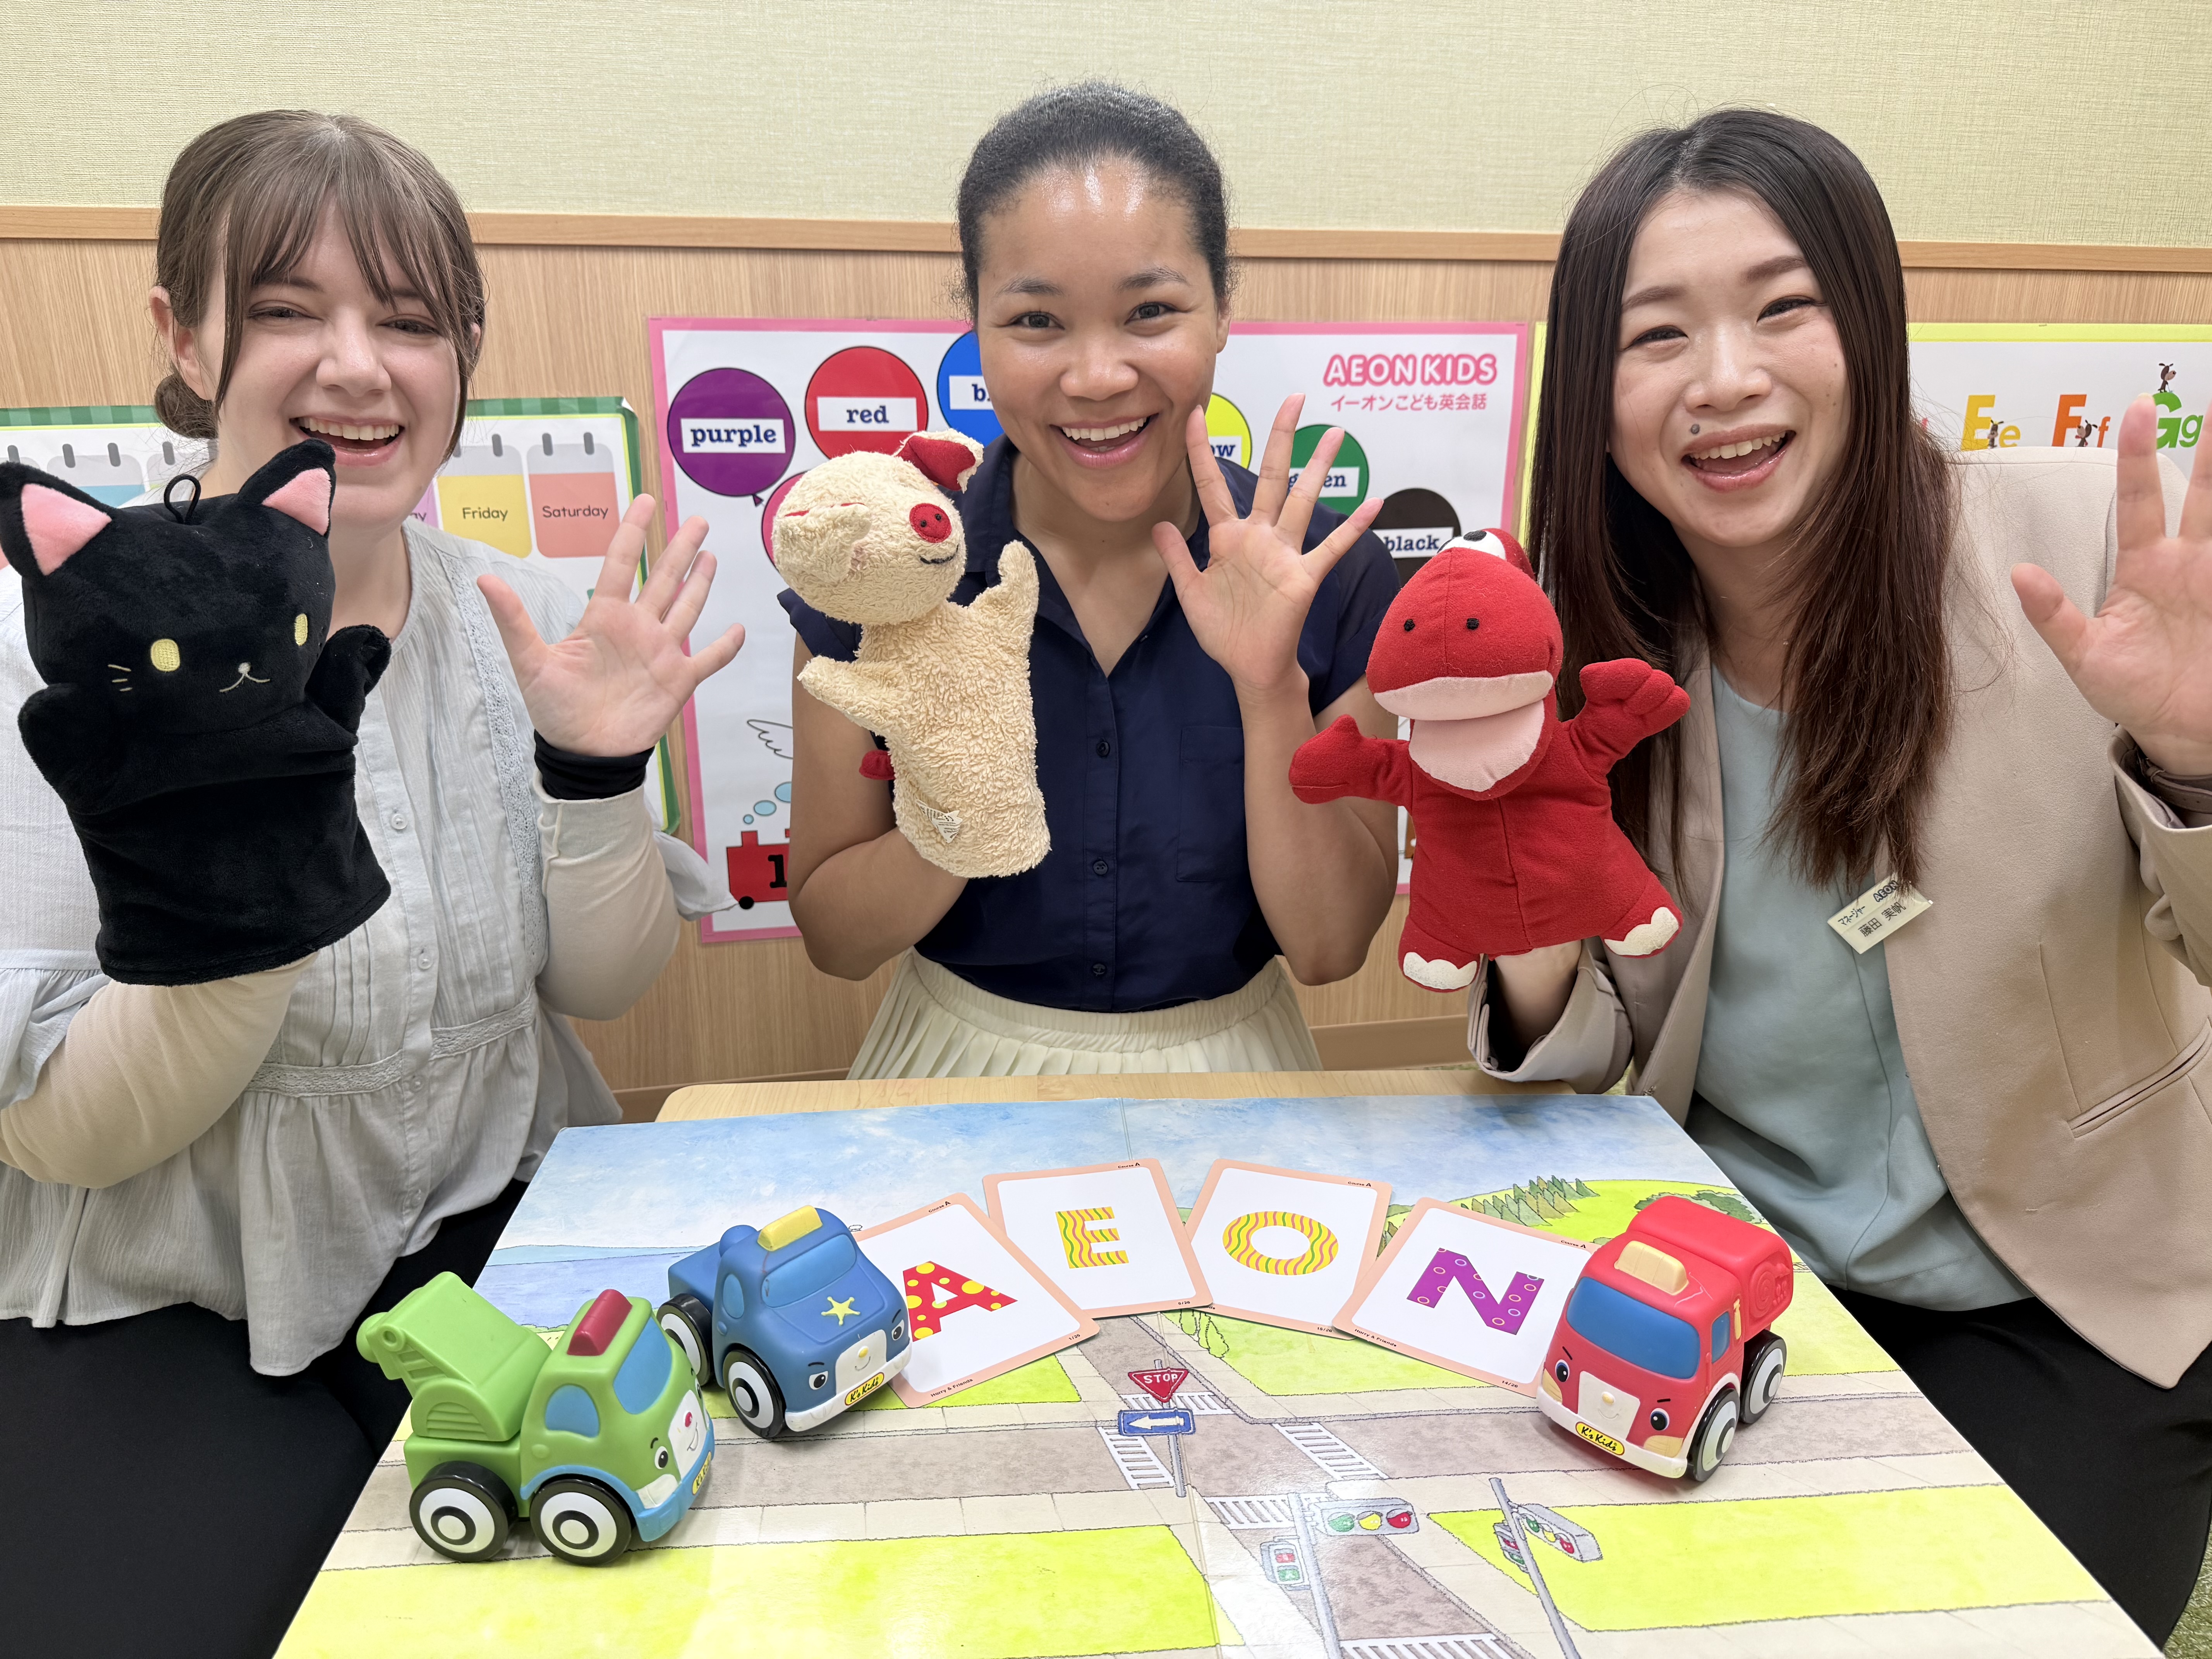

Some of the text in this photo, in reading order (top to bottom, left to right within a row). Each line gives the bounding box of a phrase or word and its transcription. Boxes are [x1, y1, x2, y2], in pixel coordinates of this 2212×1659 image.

[1323, 354, 1497, 386] AEON KIDS
[1331, 393, 1487, 412] イーオンこども英会話
[846, 405, 890, 424] red
[690, 424, 776, 447] purple
[1287, 473, 1346, 490] gen
[462, 507, 508, 521] Friday
[542, 505, 608, 519] Saturday
[1384, 534, 1439, 551] black
[768, 854, 787, 888] 1
[1873, 880, 1899, 902] AEON
[1838, 906, 1865, 926] マネージャー
[1858, 918, 1882, 937] 藤田
[1056, 1206, 1129, 1268] E
[1222, 1211, 1339, 1276] O
[1407, 1247, 1544, 1335] N
[903, 1261, 1018, 1342] A
[1376, 1337, 1397, 1347] Friends
[953, 1379, 973, 1389] Friends
[1143, 1373, 1178, 1384] STOP
[850, 1379, 878, 1402] K's Kids
[1581, 1426, 1616, 1451] K's Kids
